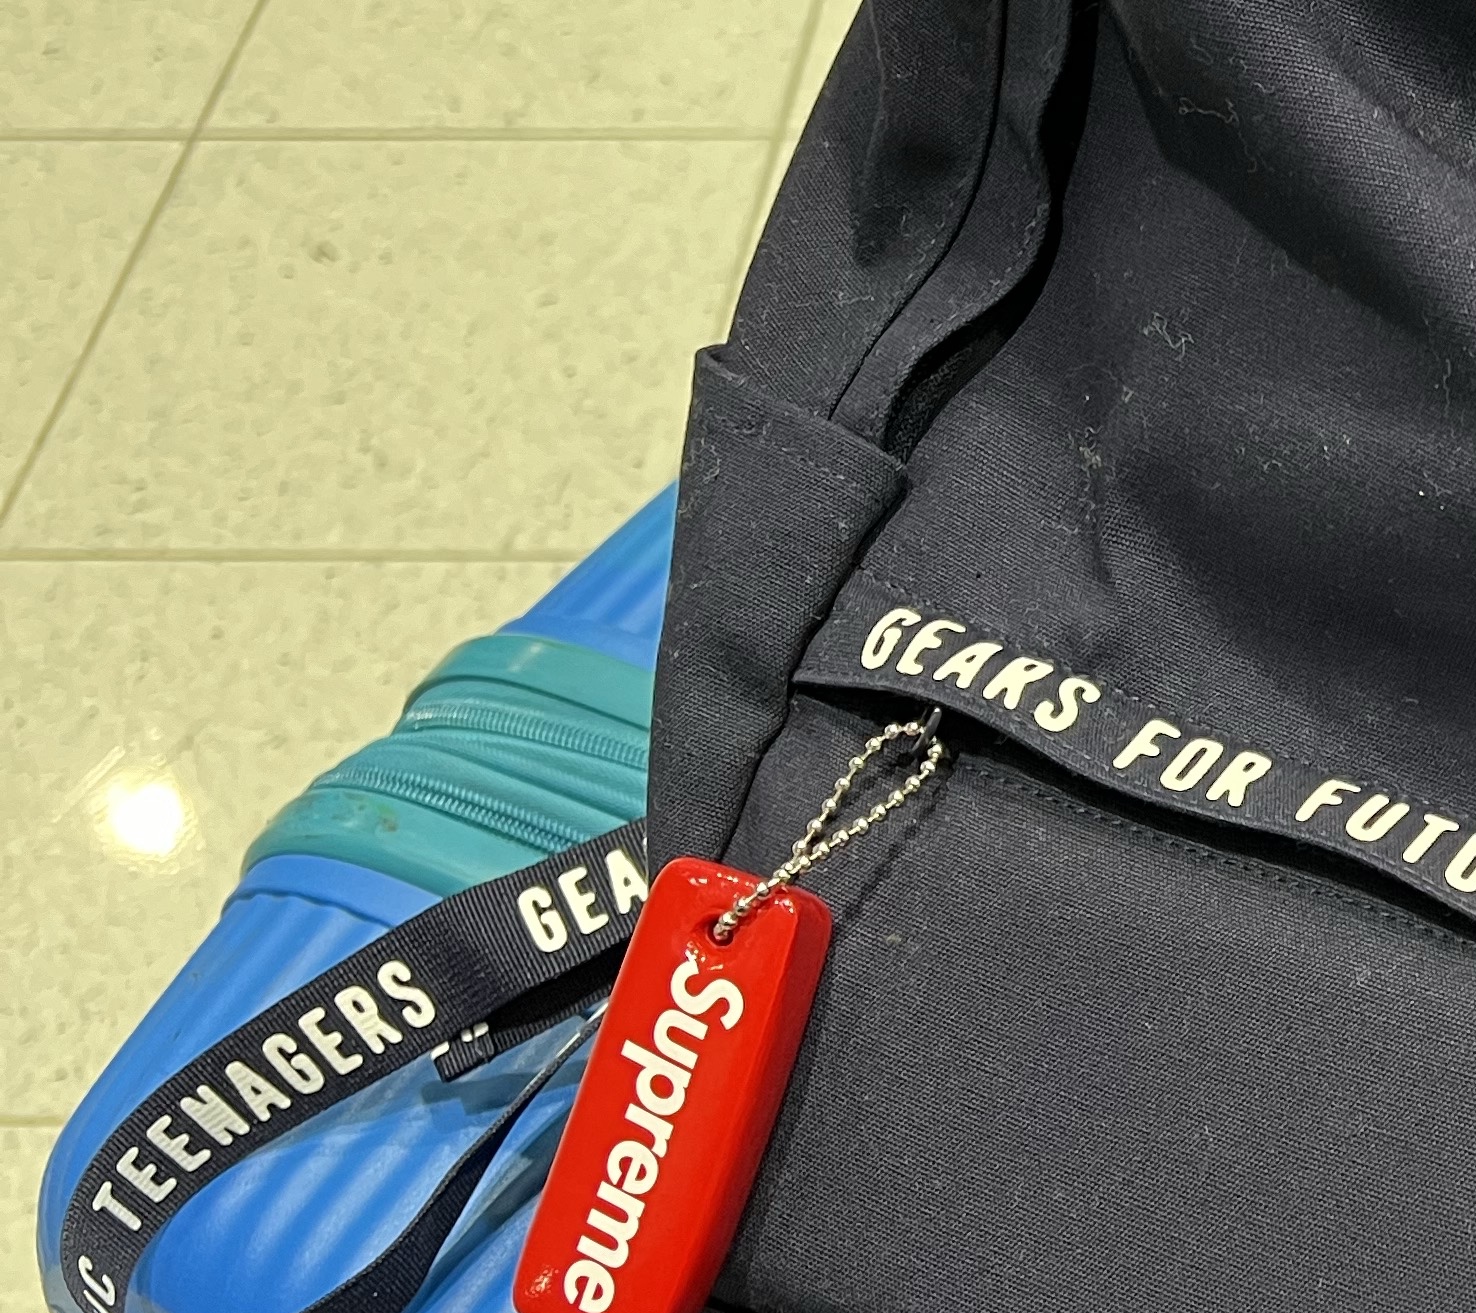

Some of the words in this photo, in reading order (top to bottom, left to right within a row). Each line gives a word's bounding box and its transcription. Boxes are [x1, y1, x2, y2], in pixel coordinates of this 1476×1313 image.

[859, 606, 1102, 733] GEARS
[1111, 718, 1273, 808] FOR
[91, 959, 437, 1232] TEENAGERS
[516, 835, 649, 954] GEA
